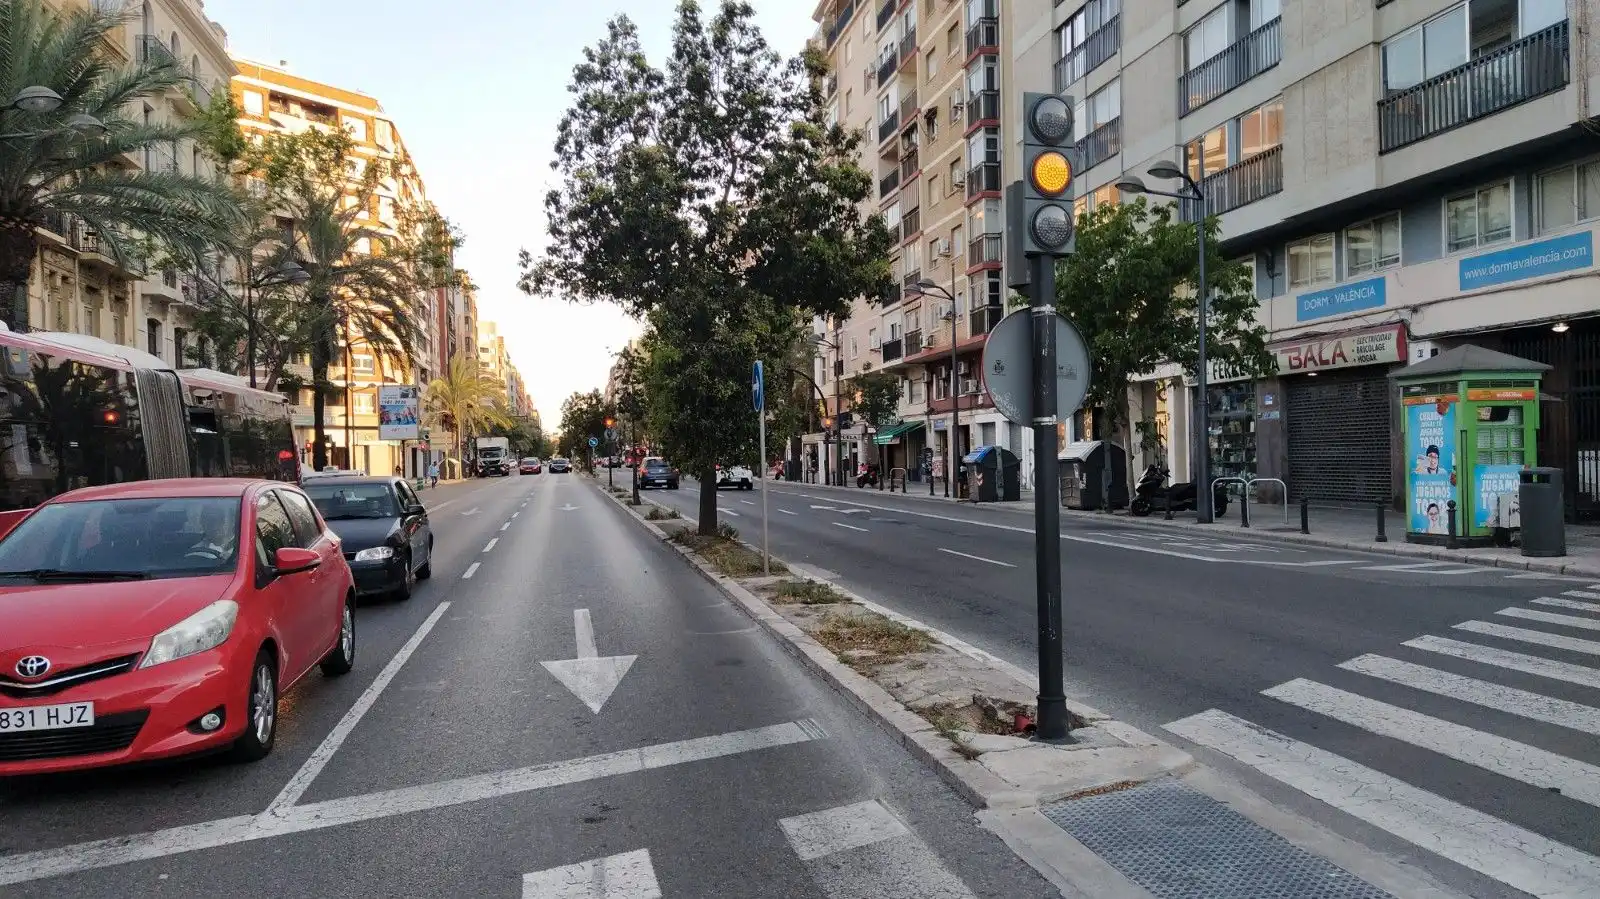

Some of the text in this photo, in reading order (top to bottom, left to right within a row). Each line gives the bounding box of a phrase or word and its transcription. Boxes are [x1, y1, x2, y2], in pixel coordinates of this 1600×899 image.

[1464, 245, 1587, 280] www.dormavalencia.com
[1356, 332, 1392, 345] ELECTRICIDAD
[1356, 343, 1386, 354] BRICOLAGE
[1280, 341, 1349, 370] BALA
[1357, 353, 1377, 363] HOGAR
[1416, 486, 1450, 499] JUGAMOS
[47, 705, 89, 726] HJZ
